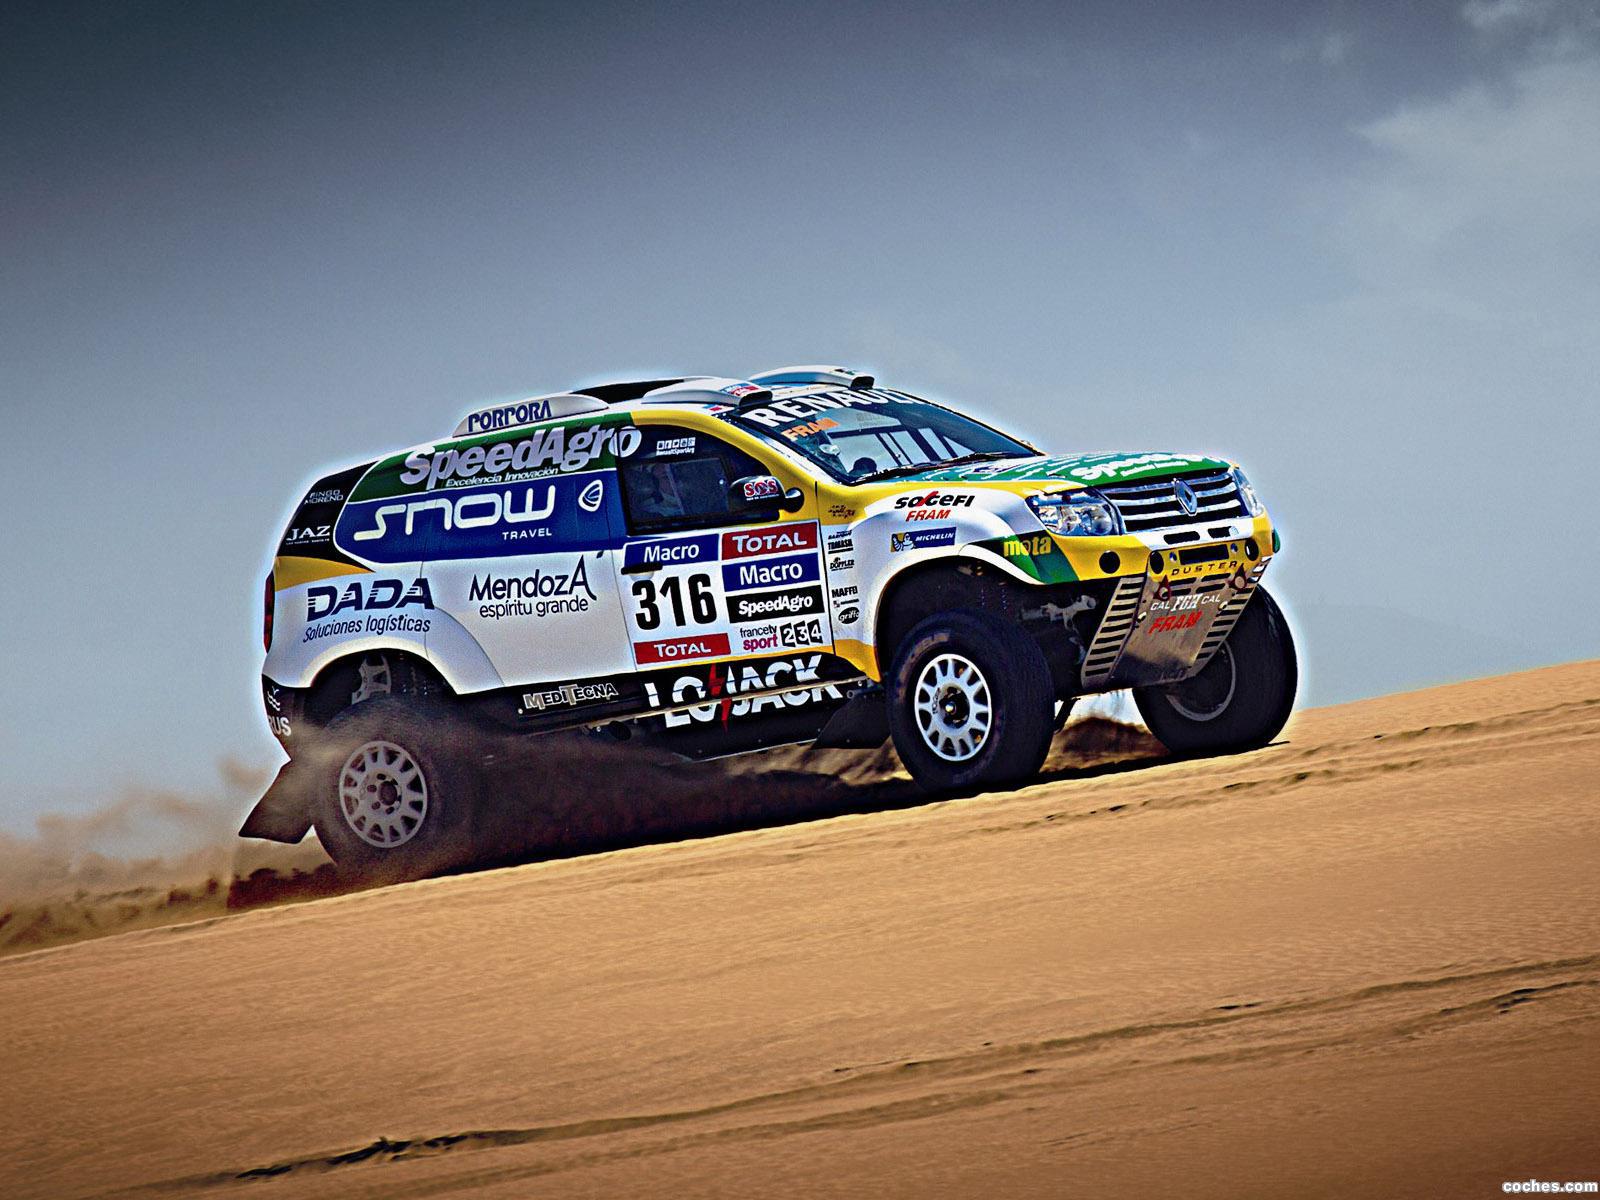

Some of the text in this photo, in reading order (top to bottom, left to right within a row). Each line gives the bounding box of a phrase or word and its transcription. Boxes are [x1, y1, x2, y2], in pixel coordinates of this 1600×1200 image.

[468, 400, 552, 432] PORPORA
[400, 424, 642, 490] SpeedAgro
[744, 479, 778, 497] SOS
[905, 509, 951, 522] FRAM
[286, 525, 331, 541] JAZ
[502, 527, 552, 541] TRAVEL
[732, 532, 808, 553] TOTAL
[915, 532, 955, 542] MICHELIN
[643, 543, 700, 563] Macro
[1003, 535, 1052, 557] mota
[739, 562, 803, 586] Macro
[1171, 561, 1238, 576] DUSTER
[307, 577, 435, 622] DADA
[480, 595, 589, 620] espíritu grande
[631, 573, 718, 631] 316
[738, 593, 813, 617] SpeedAgro
[1150, 601, 1170, 611] CAL
[1201, 594, 1220, 605] CAL
[303, 613, 431, 643] Soluciones logísticas
[739, 624, 778, 638] francetv
[1148, 610, 1203, 634] FRAM
[654, 641, 712, 658] TOTAL
[743, 634, 779, 653] sport
